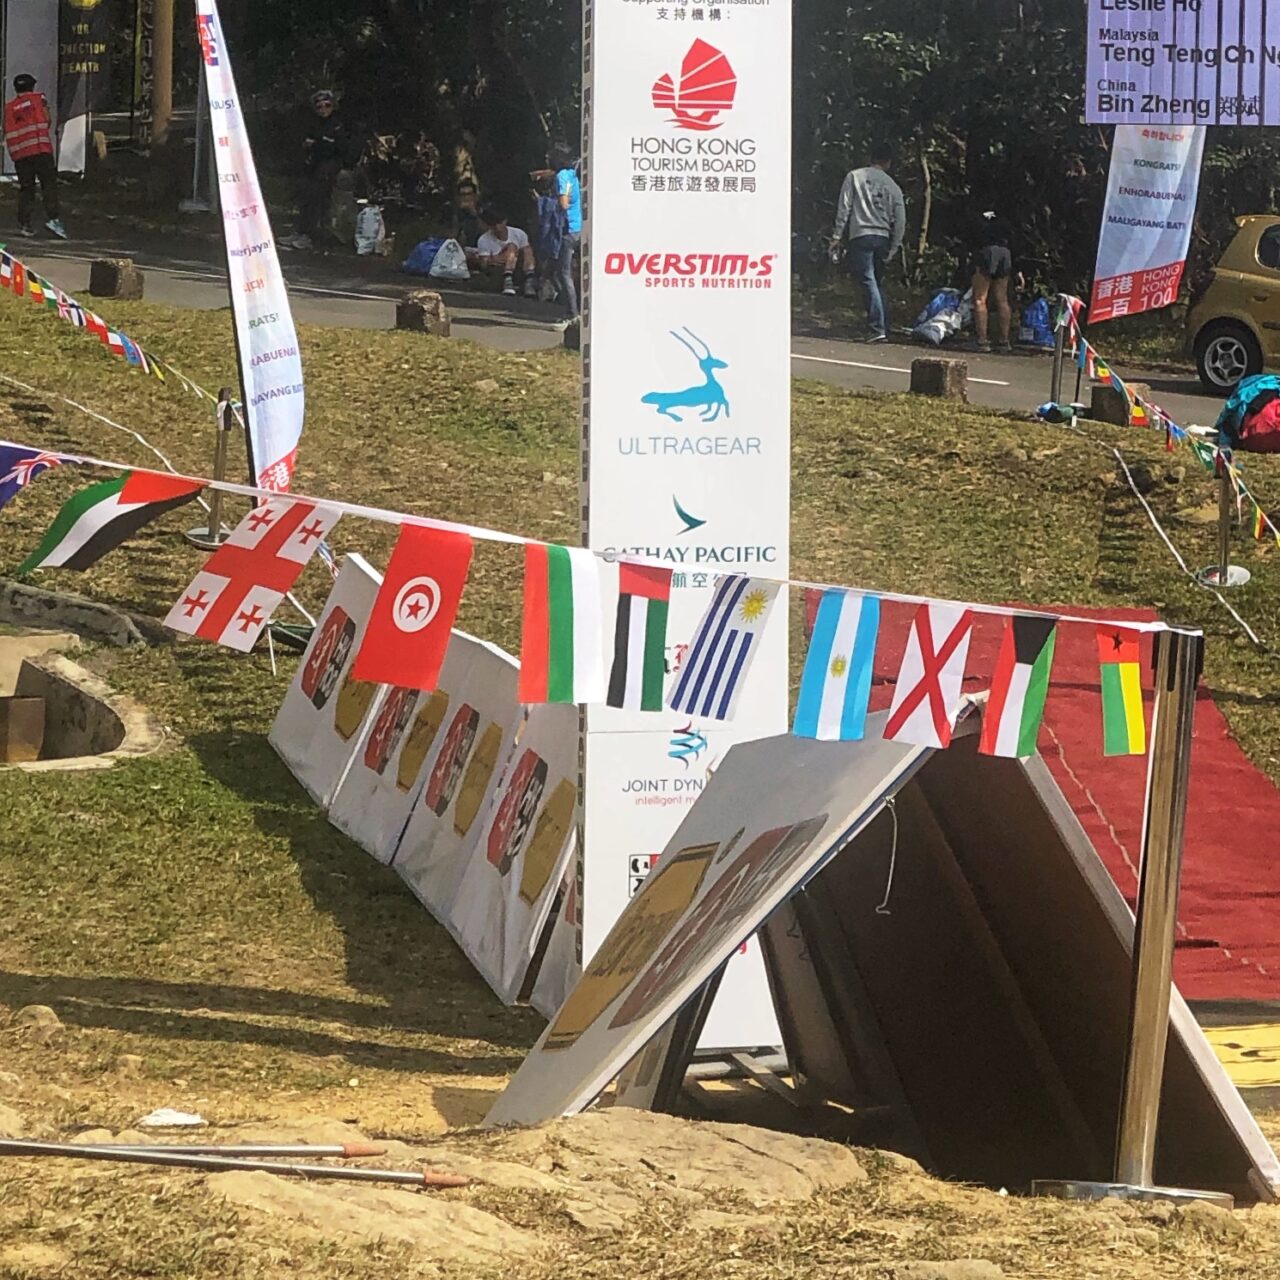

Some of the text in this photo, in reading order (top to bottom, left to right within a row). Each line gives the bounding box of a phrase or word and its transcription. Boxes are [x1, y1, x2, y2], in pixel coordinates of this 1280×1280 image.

[1099, 29, 1159, 42] Malaysia
[1099, 43, 1155, 67] Teng
[1163, 44, 1218, 68] Teng
[1097, 79, 1136, 92] China
[1098, 94, 1134, 113] Bin
[1140, 95, 1210, 118] Zheng
[631, 137, 756, 155] HONG KONG
[631, 157, 756, 173] TOURISM BOARD
[631, 175, 756, 193] 香港旅遊發展局
[1142, 265, 1180, 282] HONG
[645, 277, 772, 289] SPORTS NUTRITION
[1097, 275, 1133, 300] 香港
[1140, 276, 1176, 294] KONG
[1093, 297, 1131, 317] 一百
[1139, 287, 1173, 312] 100
[248, 312, 280, 330] RATS!
[618, 436, 762, 456] ULTRAGEAR
[695, 546, 777, 563] PACIFIC
[622, 779, 703, 793] JOINT DYN
[635, 795, 682, 807] intelligent
